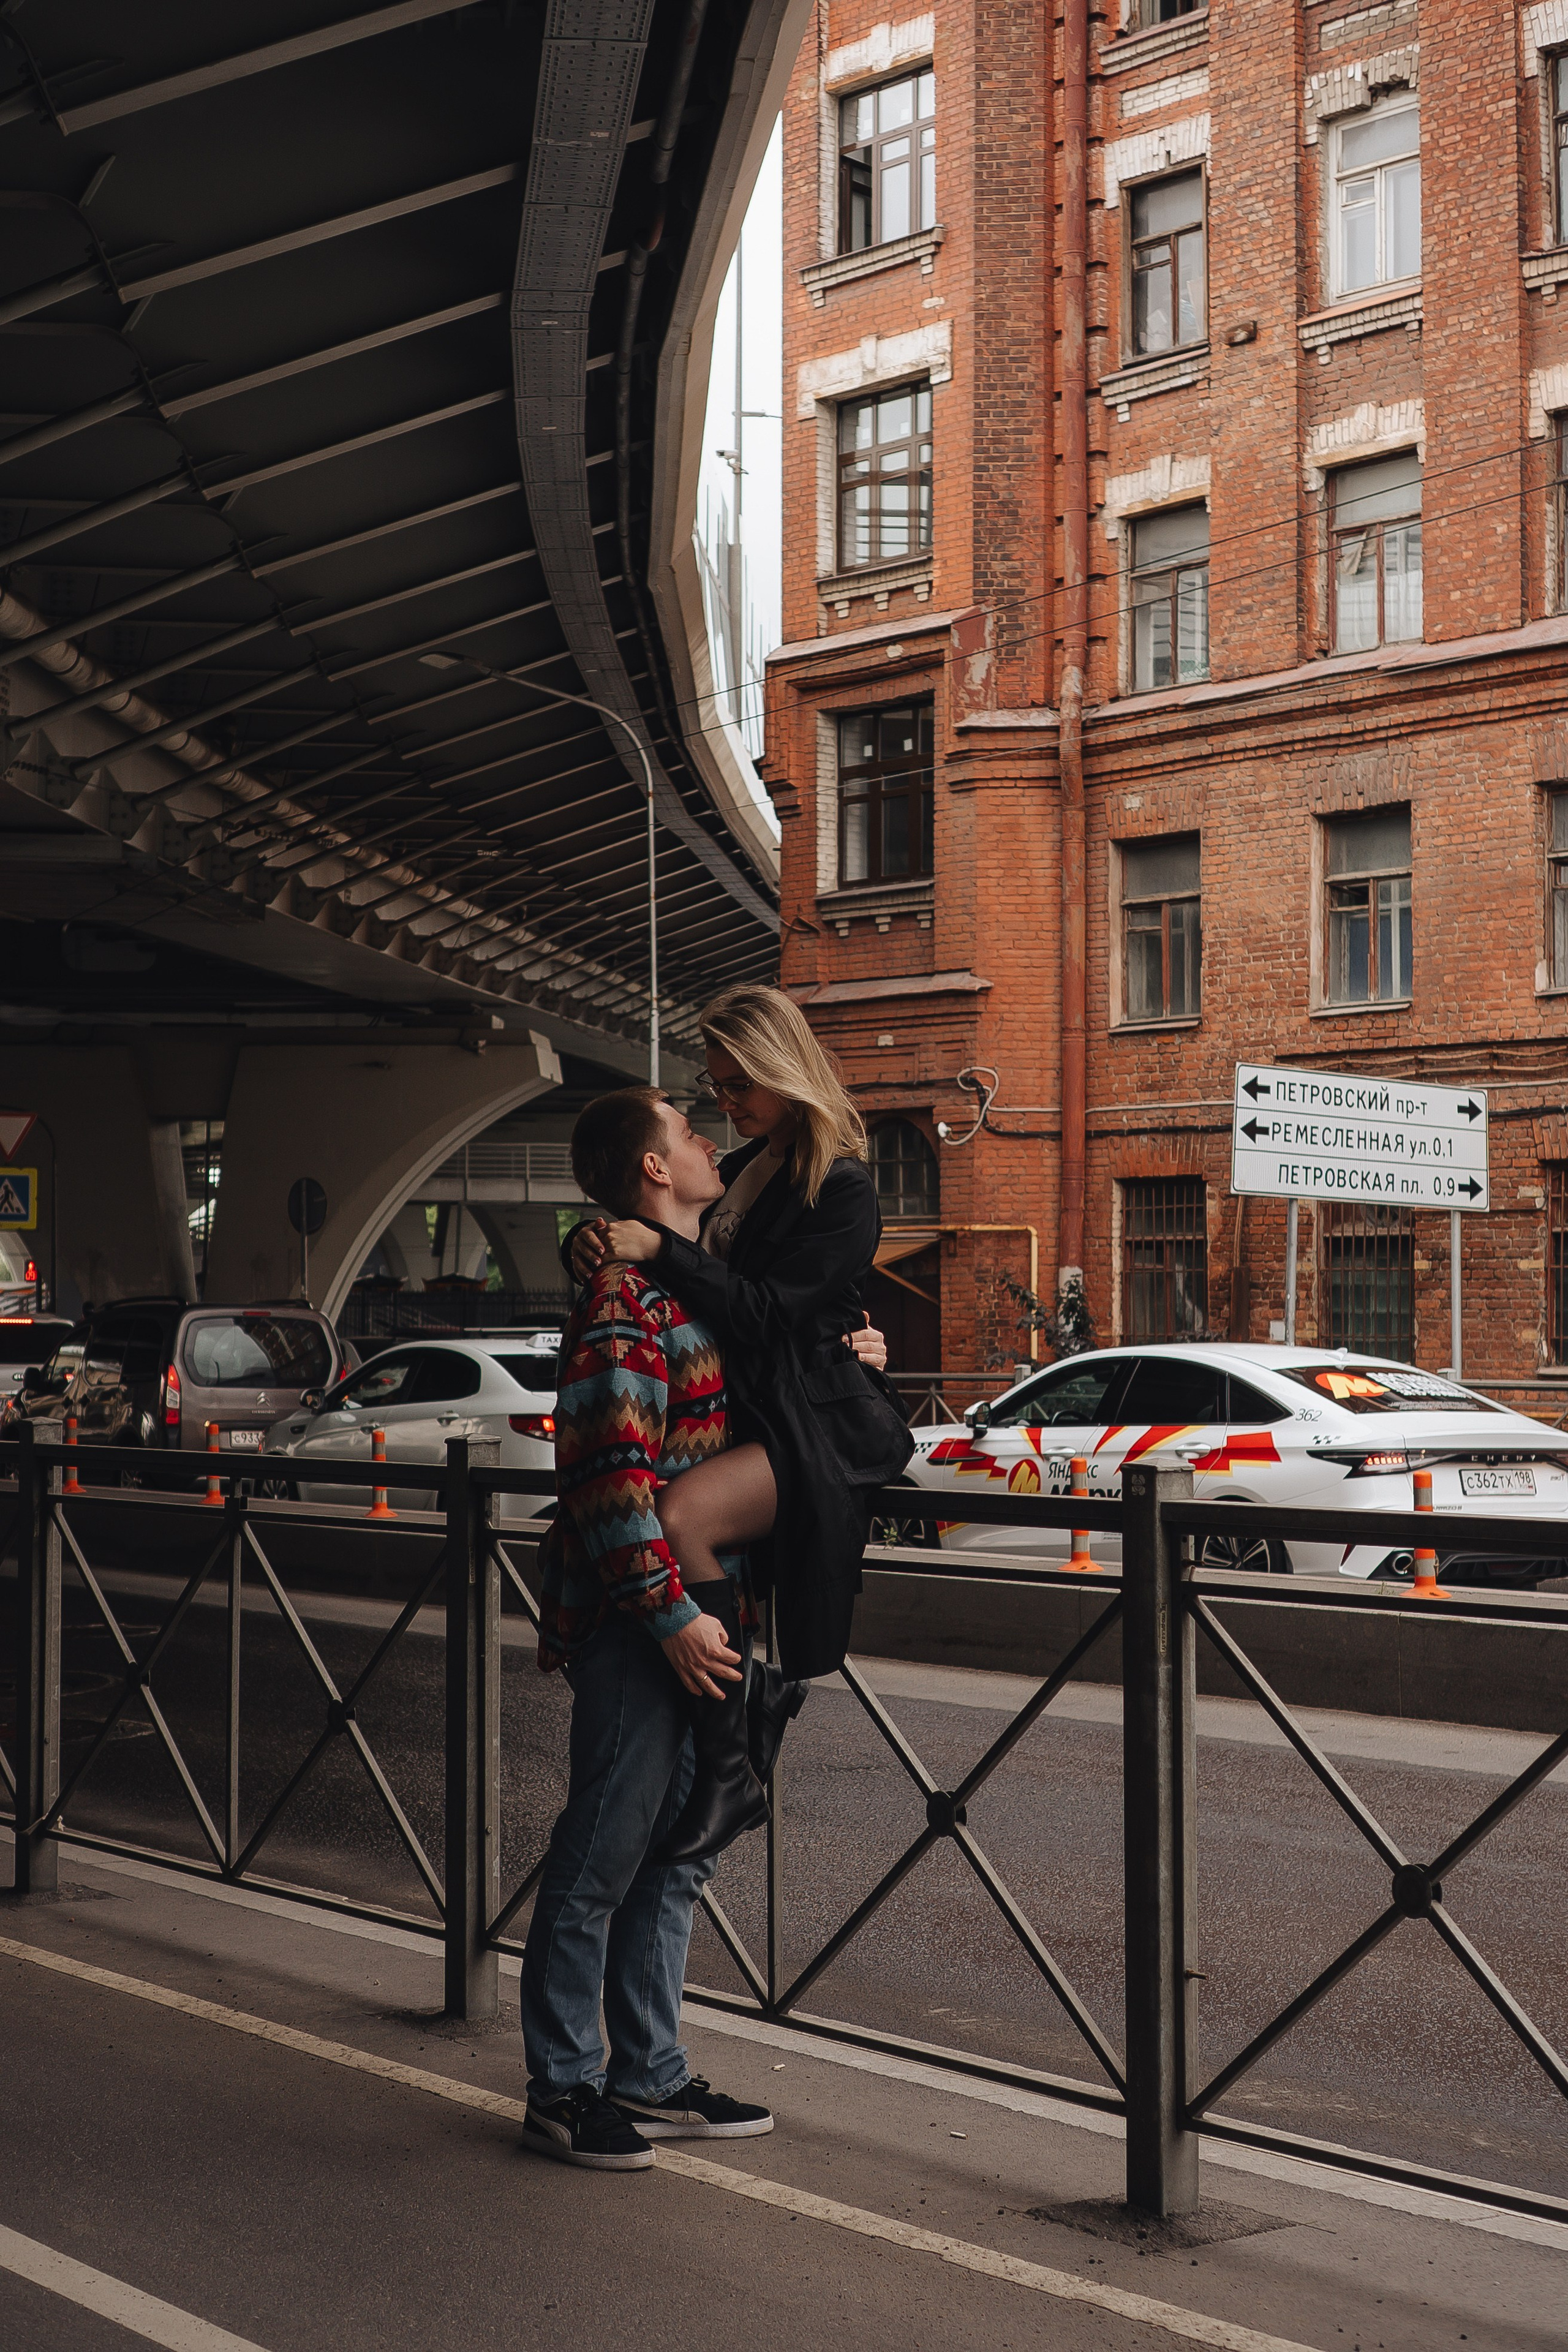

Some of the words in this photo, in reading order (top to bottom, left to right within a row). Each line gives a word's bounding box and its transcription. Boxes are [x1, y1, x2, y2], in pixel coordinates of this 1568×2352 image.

[1276, 1081, 1390, 1111] ПЕТРОВСКИЙ
[1396, 1098, 1428, 1118] пр-т
[1272, 1122, 1404, 1153] РЕМЕСЛЕННАЯ
[1278, 1164, 1395, 1193] ПЕТРОВСКАЯ
[1401, 1180, 1423, 1194] пл.
[1433, 1177, 1455, 1198] 0,9
[1295, 1408, 1322, 1422] 362
[1515, 1471, 1531, 1484] 198
